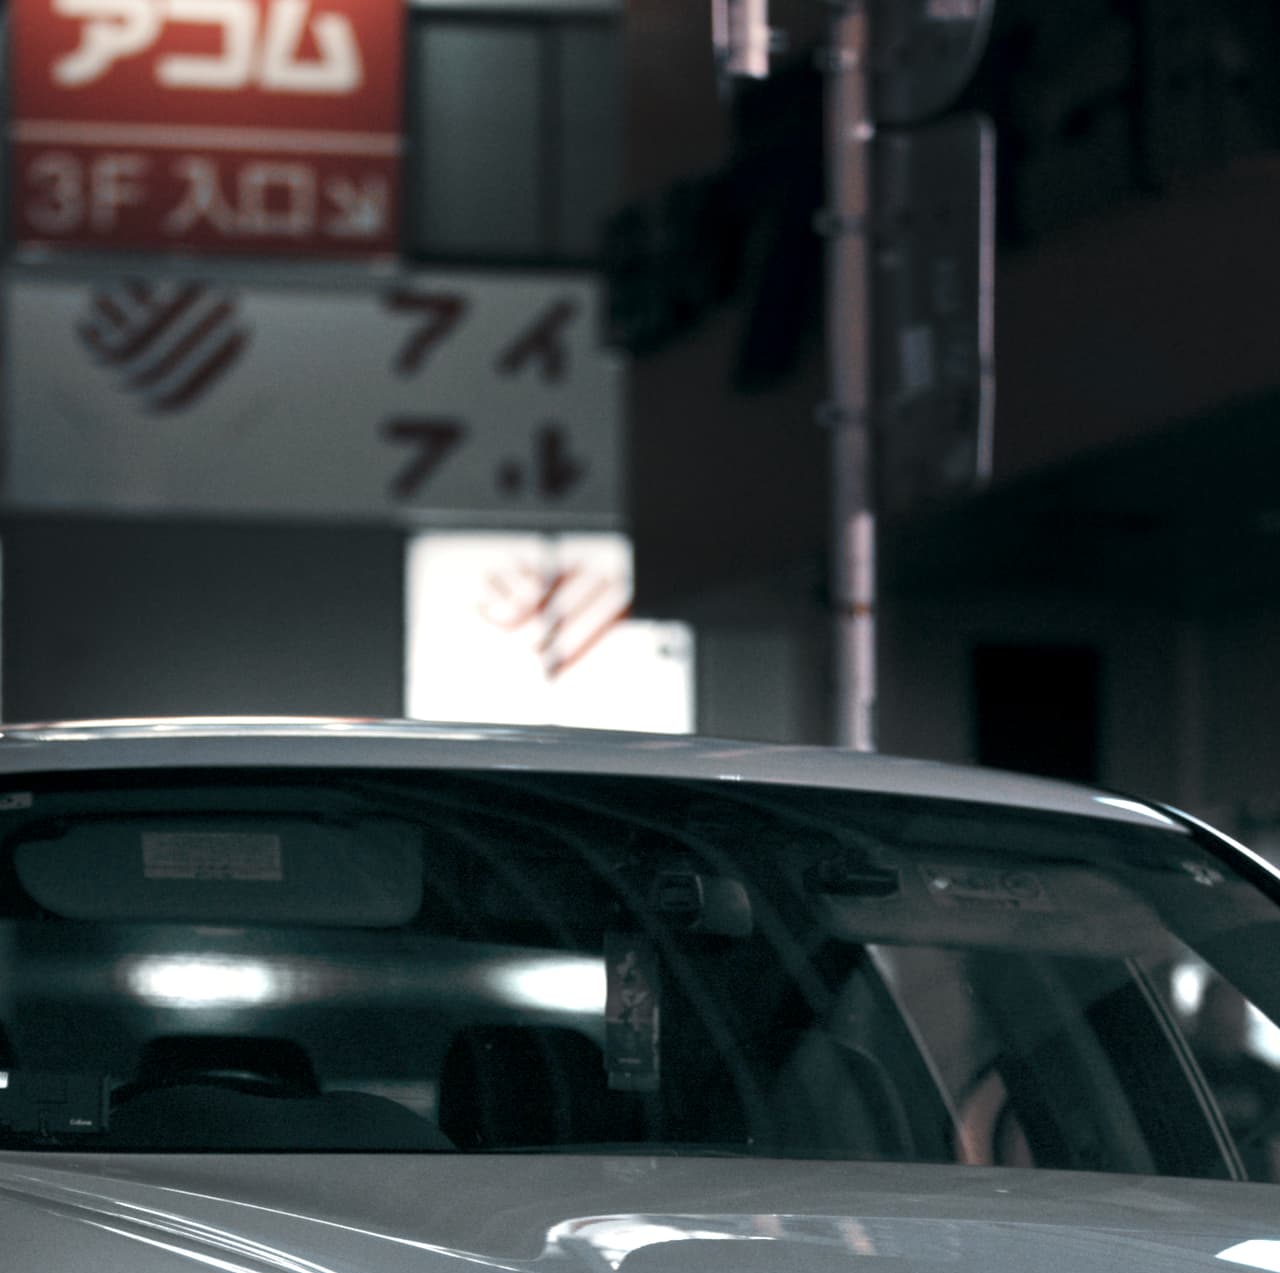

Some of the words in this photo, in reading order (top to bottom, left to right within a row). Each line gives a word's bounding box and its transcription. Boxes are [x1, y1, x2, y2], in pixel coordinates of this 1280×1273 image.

[50, 0, 363, 94] アコム
[25, 152, 145, 234] 3F
[161, 157, 318, 237] 入口
